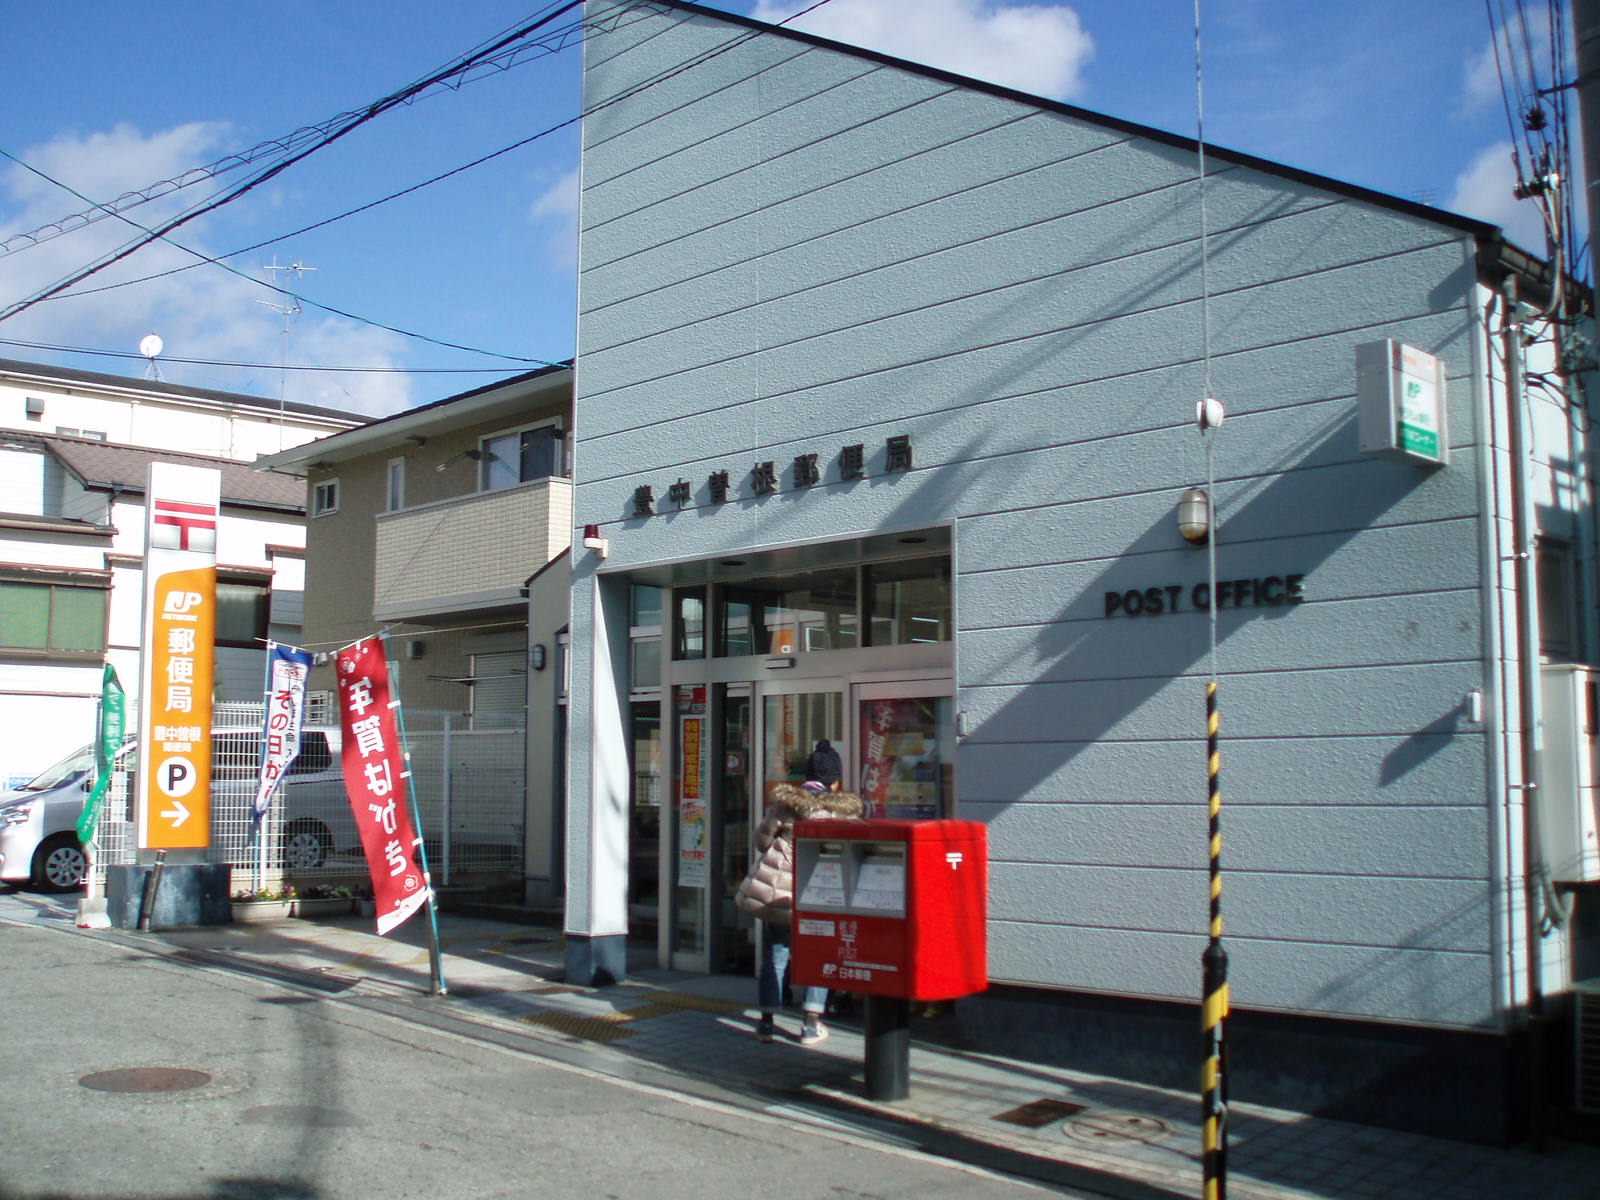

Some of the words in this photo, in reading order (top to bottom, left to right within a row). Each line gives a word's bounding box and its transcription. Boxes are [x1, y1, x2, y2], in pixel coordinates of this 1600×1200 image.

[163, 590, 203, 612] JP
[1104, 585, 1183, 618] POST
[1192, 574, 1306, 612] OFFICE
[165, 626, 196, 713] 郵便局
[167, 763, 187, 790] P
